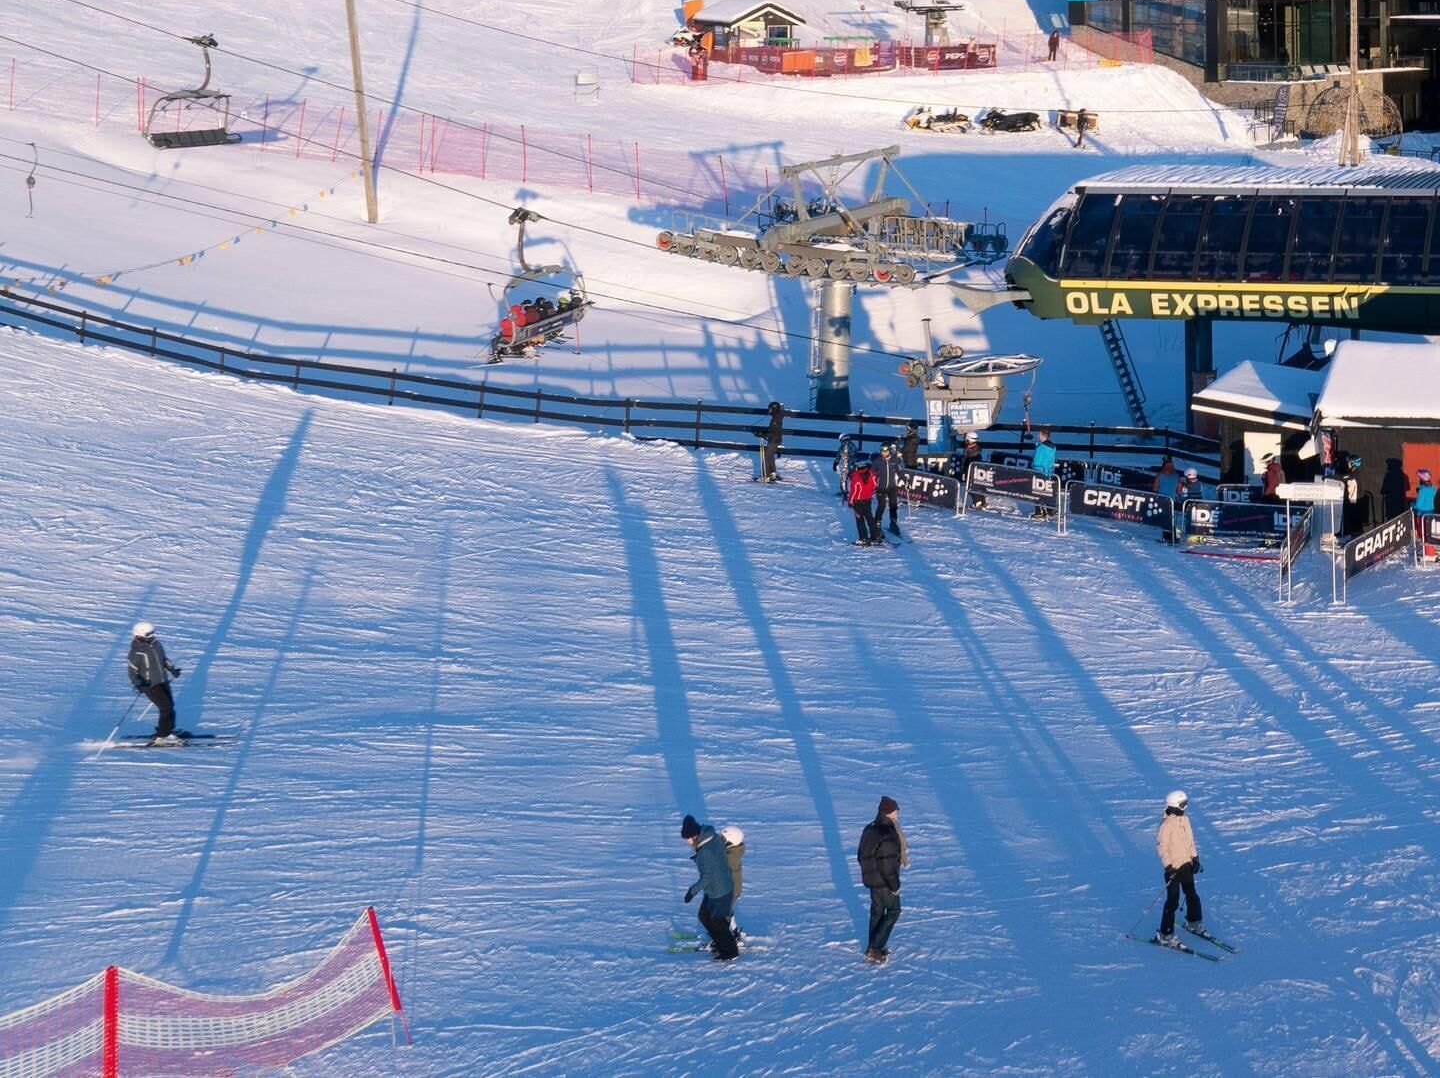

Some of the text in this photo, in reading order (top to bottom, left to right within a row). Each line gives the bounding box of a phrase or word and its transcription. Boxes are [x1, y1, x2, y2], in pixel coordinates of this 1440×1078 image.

[1066, 291, 1360, 320] OLA EXPRESSEN
[974, 465, 994, 483] IDÉ
[1083, 489, 1146, 512] CRAFT
[1191, 507, 1220, 523] IDÉ
[1354, 525, 1396, 561] CRAFT
